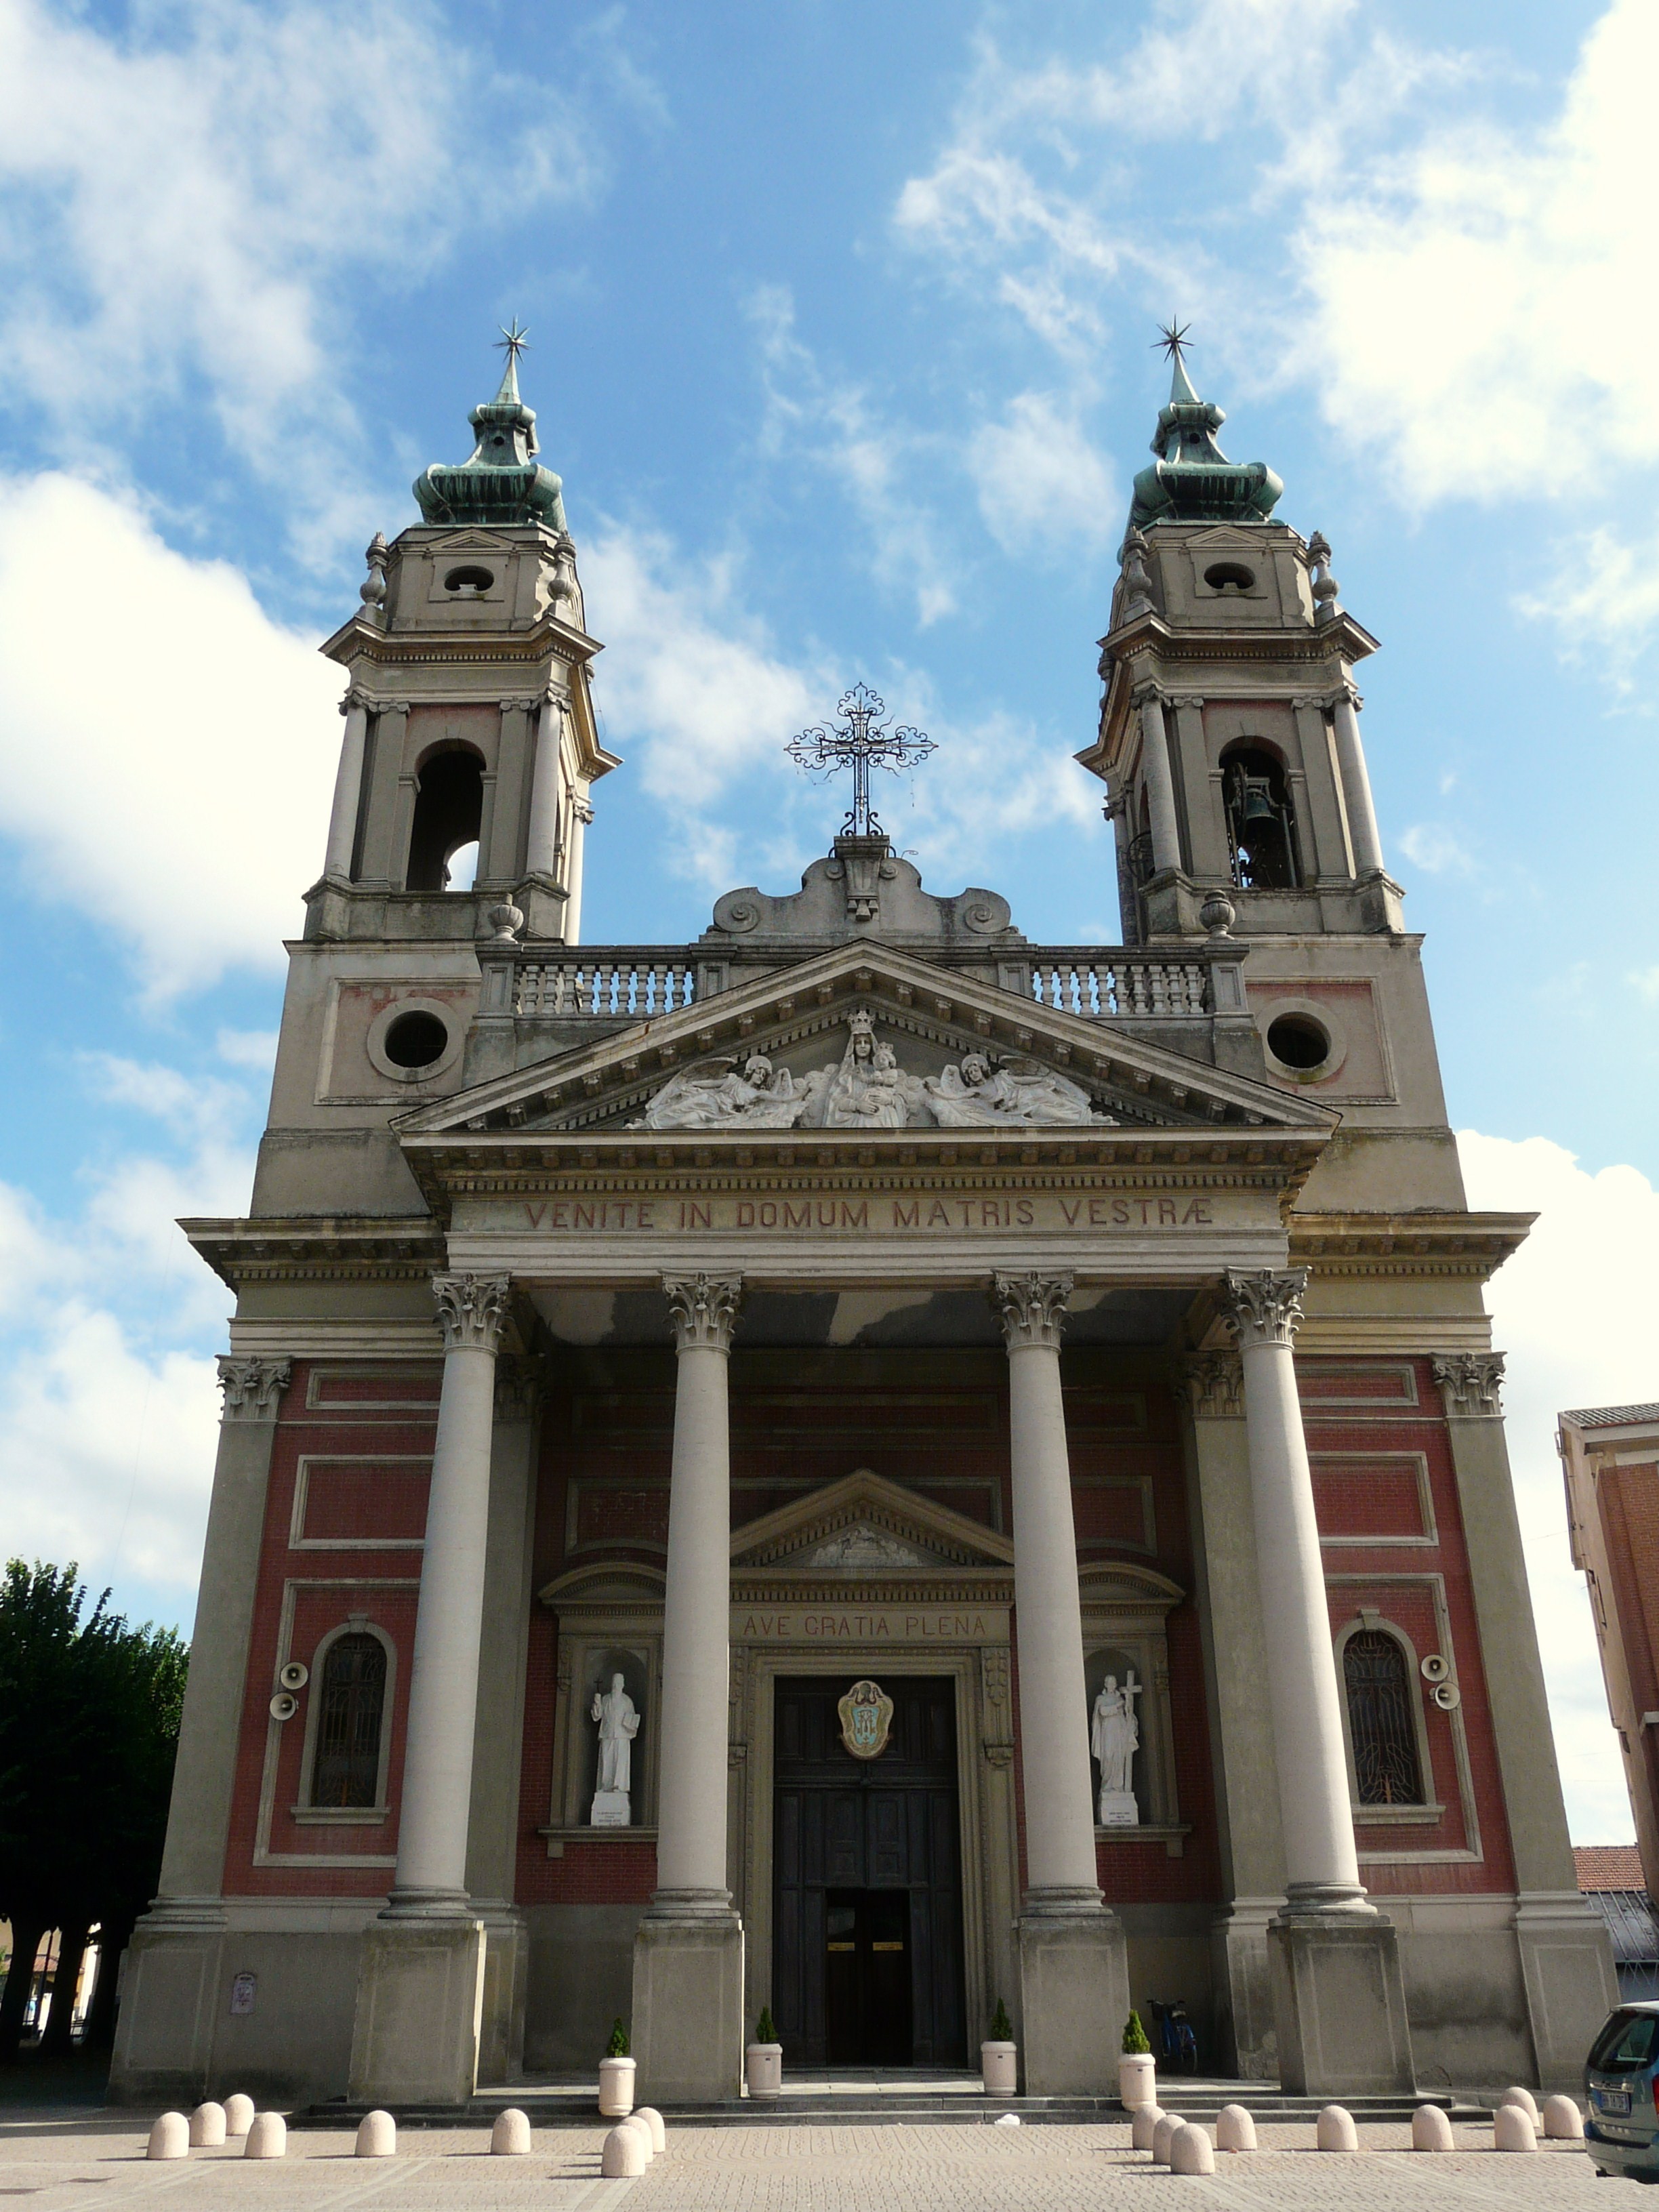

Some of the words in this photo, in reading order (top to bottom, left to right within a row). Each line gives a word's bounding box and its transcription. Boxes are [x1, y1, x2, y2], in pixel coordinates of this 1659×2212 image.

[523, 1202, 655, 1229] VENITE
[680, 1202, 711, 1229] IN
[737, 1201, 868, 1227] DOMUM
[893, 1200, 1034, 1227] MATRIS
[743, 1616, 791, 1635] AVE
[804, 1616, 890, 1636] GRATIA
[905, 1616, 986, 1635] PLENA
